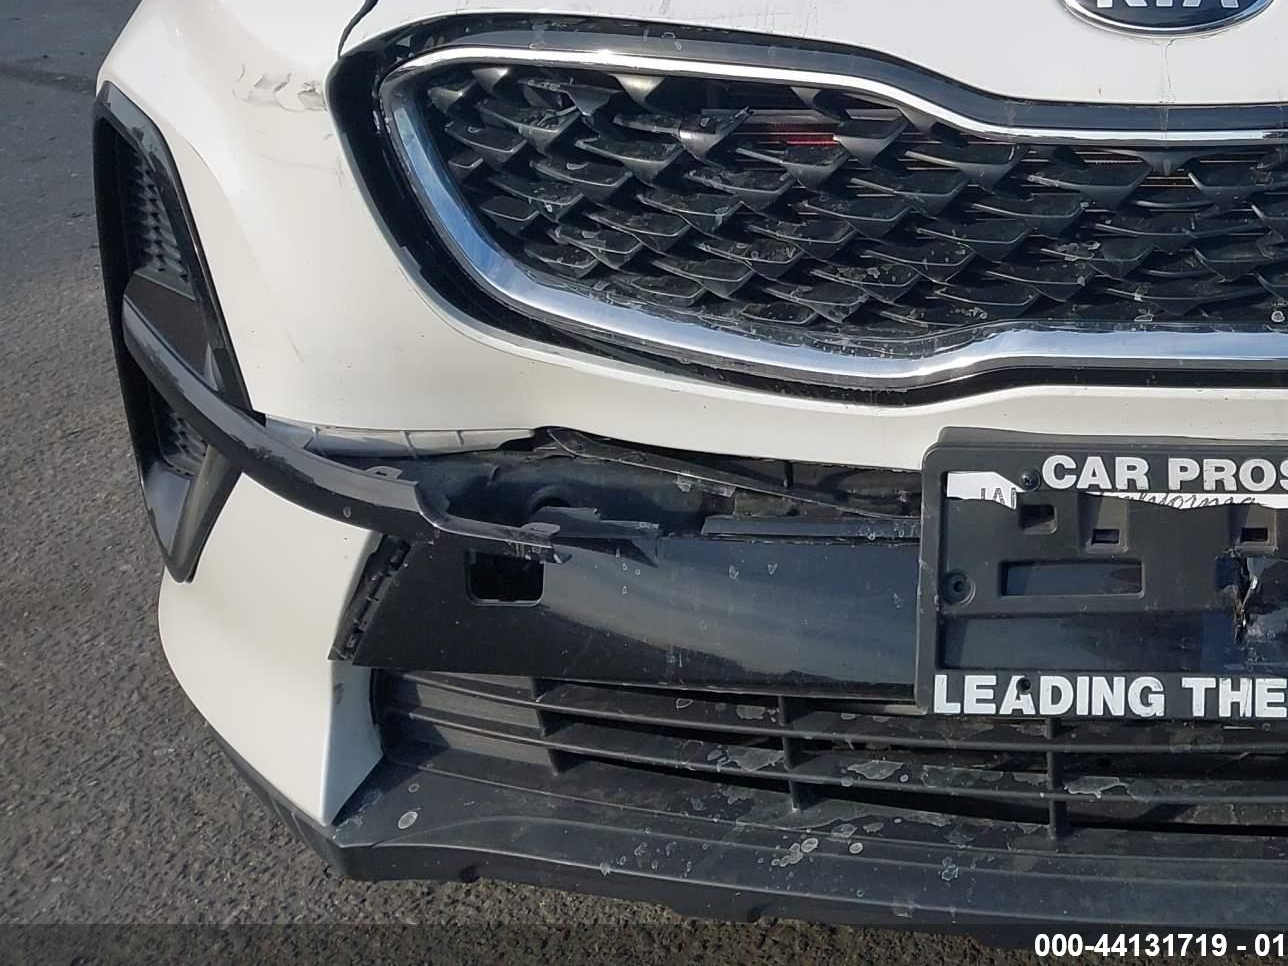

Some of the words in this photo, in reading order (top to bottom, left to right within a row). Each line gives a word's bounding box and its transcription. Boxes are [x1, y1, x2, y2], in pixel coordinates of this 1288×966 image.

[1042, 455, 1149, 492] CAR
[933, 674, 1165, 718] LEADING
[1182, 677, 1288, 718] THE
